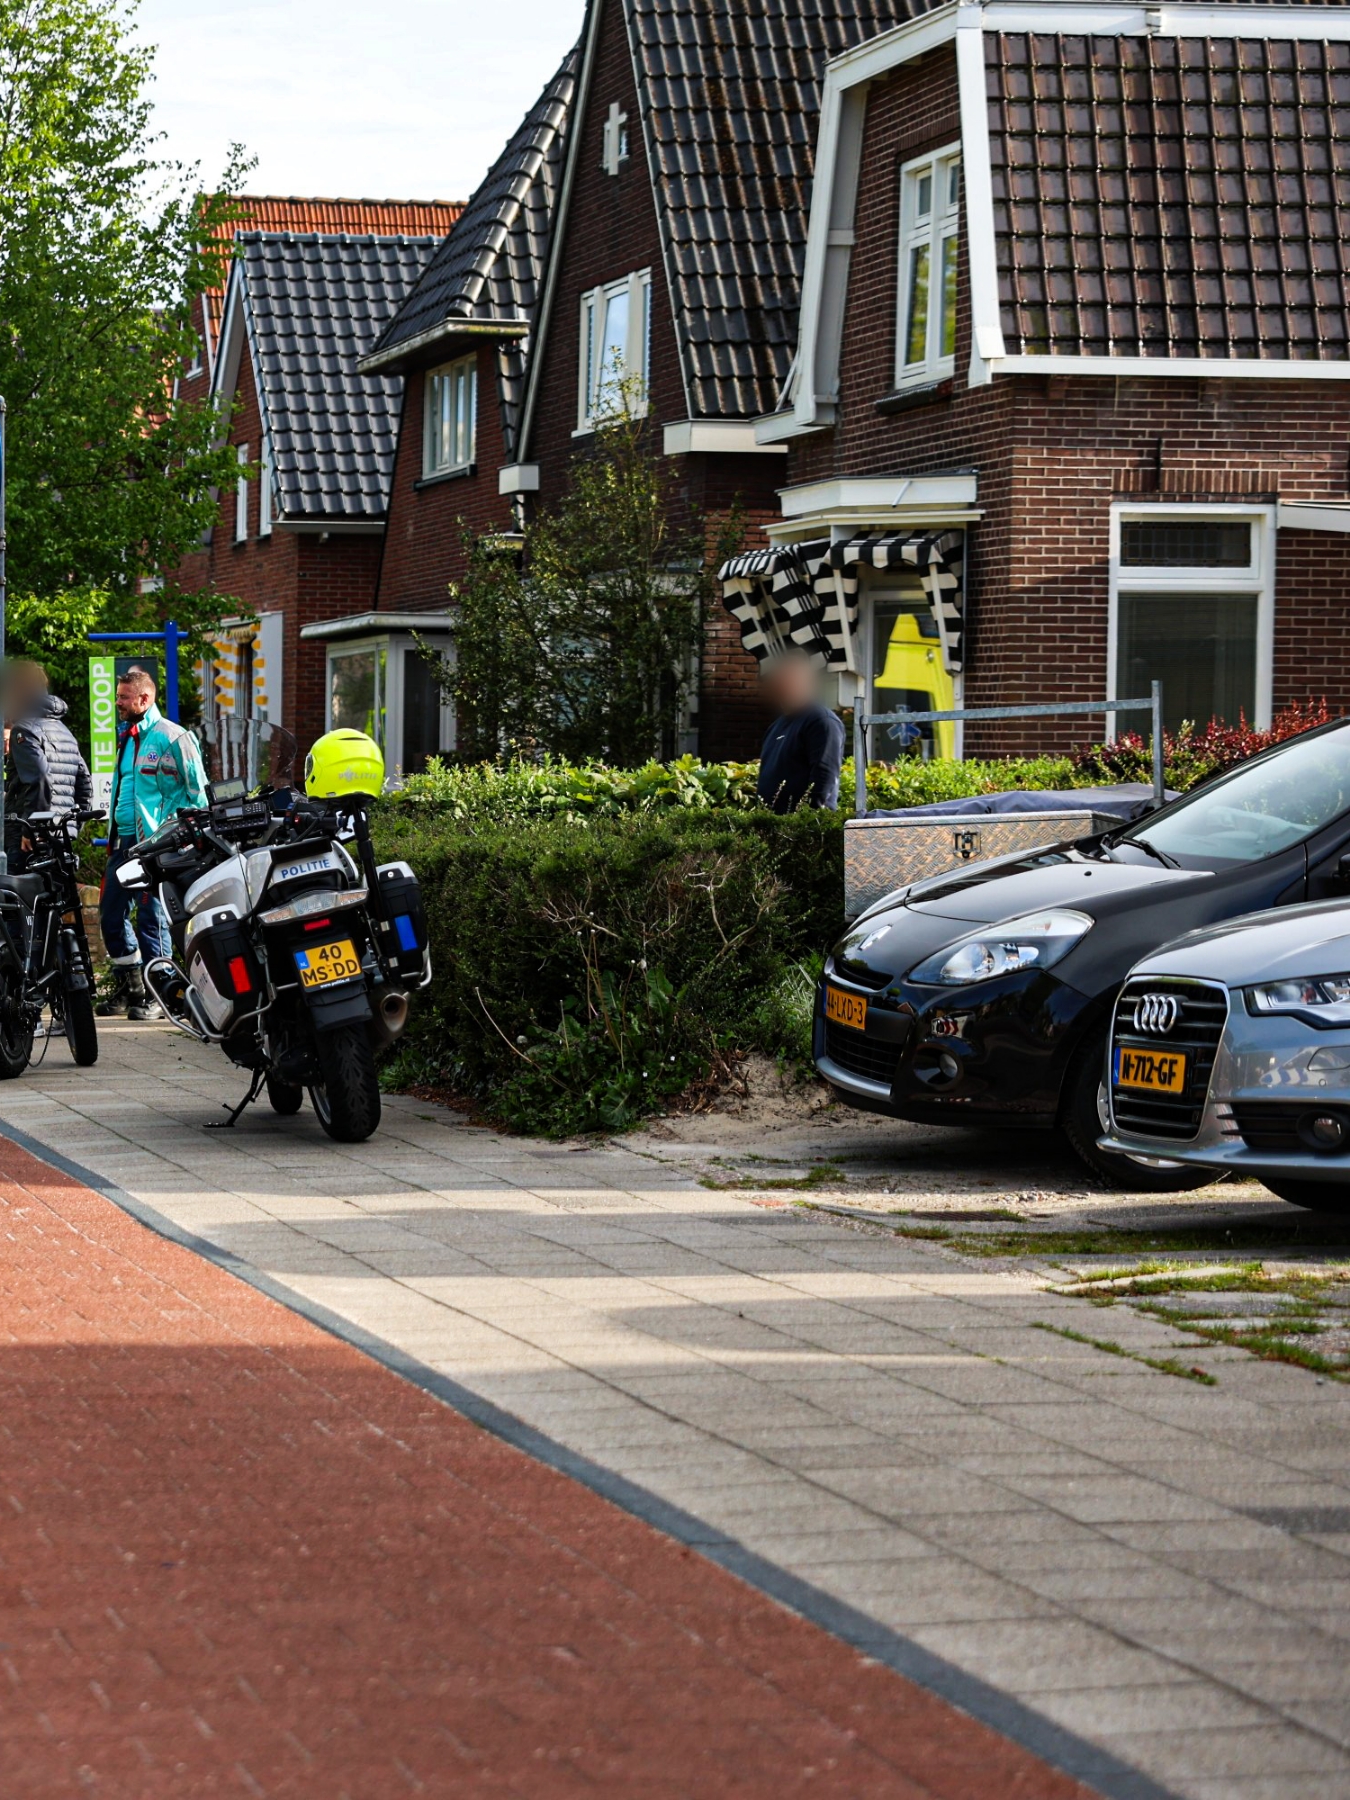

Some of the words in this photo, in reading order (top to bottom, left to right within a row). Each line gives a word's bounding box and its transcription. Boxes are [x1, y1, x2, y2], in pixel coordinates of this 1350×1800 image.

[91, 662, 113, 733] KOOP
[93, 741, 114, 772] TE
[338, 767, 377, 781] POLITIE
[281, 859, 331, 879] POLITIE
[318, 945, 342, 962] 40
[301, 958, 358, 985] MS-DD
[827, 991, 863, 1024] 44-LXD-3
[1122, 1053, 1178, 1086] N-712-GF
